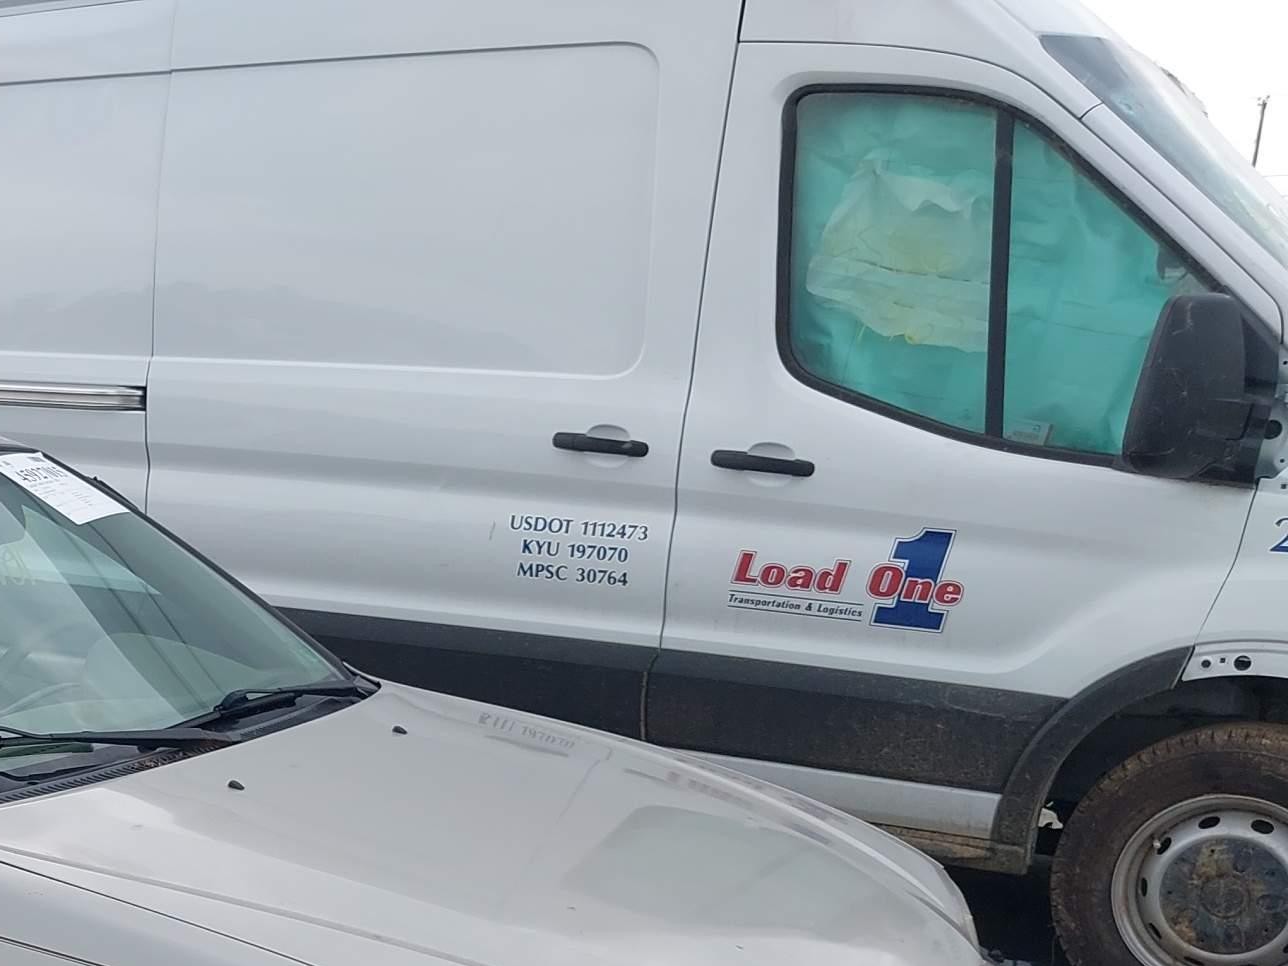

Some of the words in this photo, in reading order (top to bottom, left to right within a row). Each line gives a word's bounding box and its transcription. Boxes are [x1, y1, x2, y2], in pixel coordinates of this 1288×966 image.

[510, 514, 574, 535] USDOT
[581, 521, 649, 542] 1112473
[522, 538, 561, 558] KYU
[568, 543, 629, 564] 197070
[517, 562, 569, 582] MPSC
[576, 567, 629, 587] 30764
[732, 551, 851, 594] Load
[867, 563, 964, 606] One
[728, 592, 801, 611] Transportation
[804, 602, 813, 612] &
[817, 603, 863, 618] Logistics
